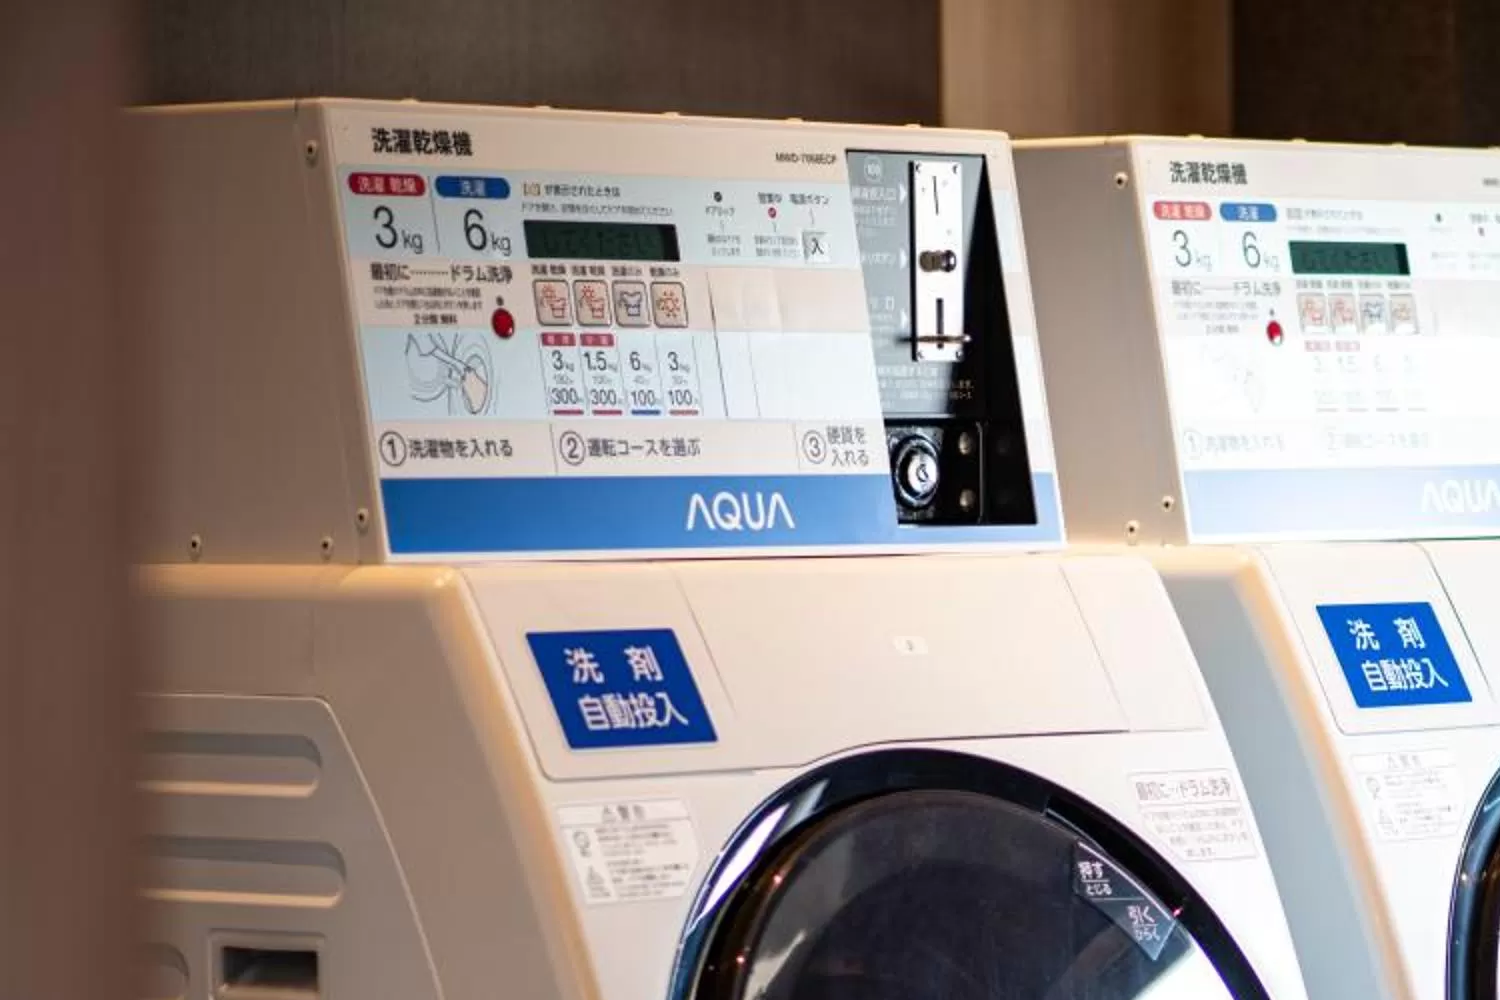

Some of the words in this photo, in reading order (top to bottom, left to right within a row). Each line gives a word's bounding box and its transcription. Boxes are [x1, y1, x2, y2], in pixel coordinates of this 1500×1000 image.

[371, 127, 473, 156] 洗濯乾燥機
[1169, 160, 1248, 185] 洗濯乾燥機
[687, 491, 796, 531] AQUA
[1362, 658, 1449, 692] 自動投入
[578, 692, 689, 731] 自動投入
